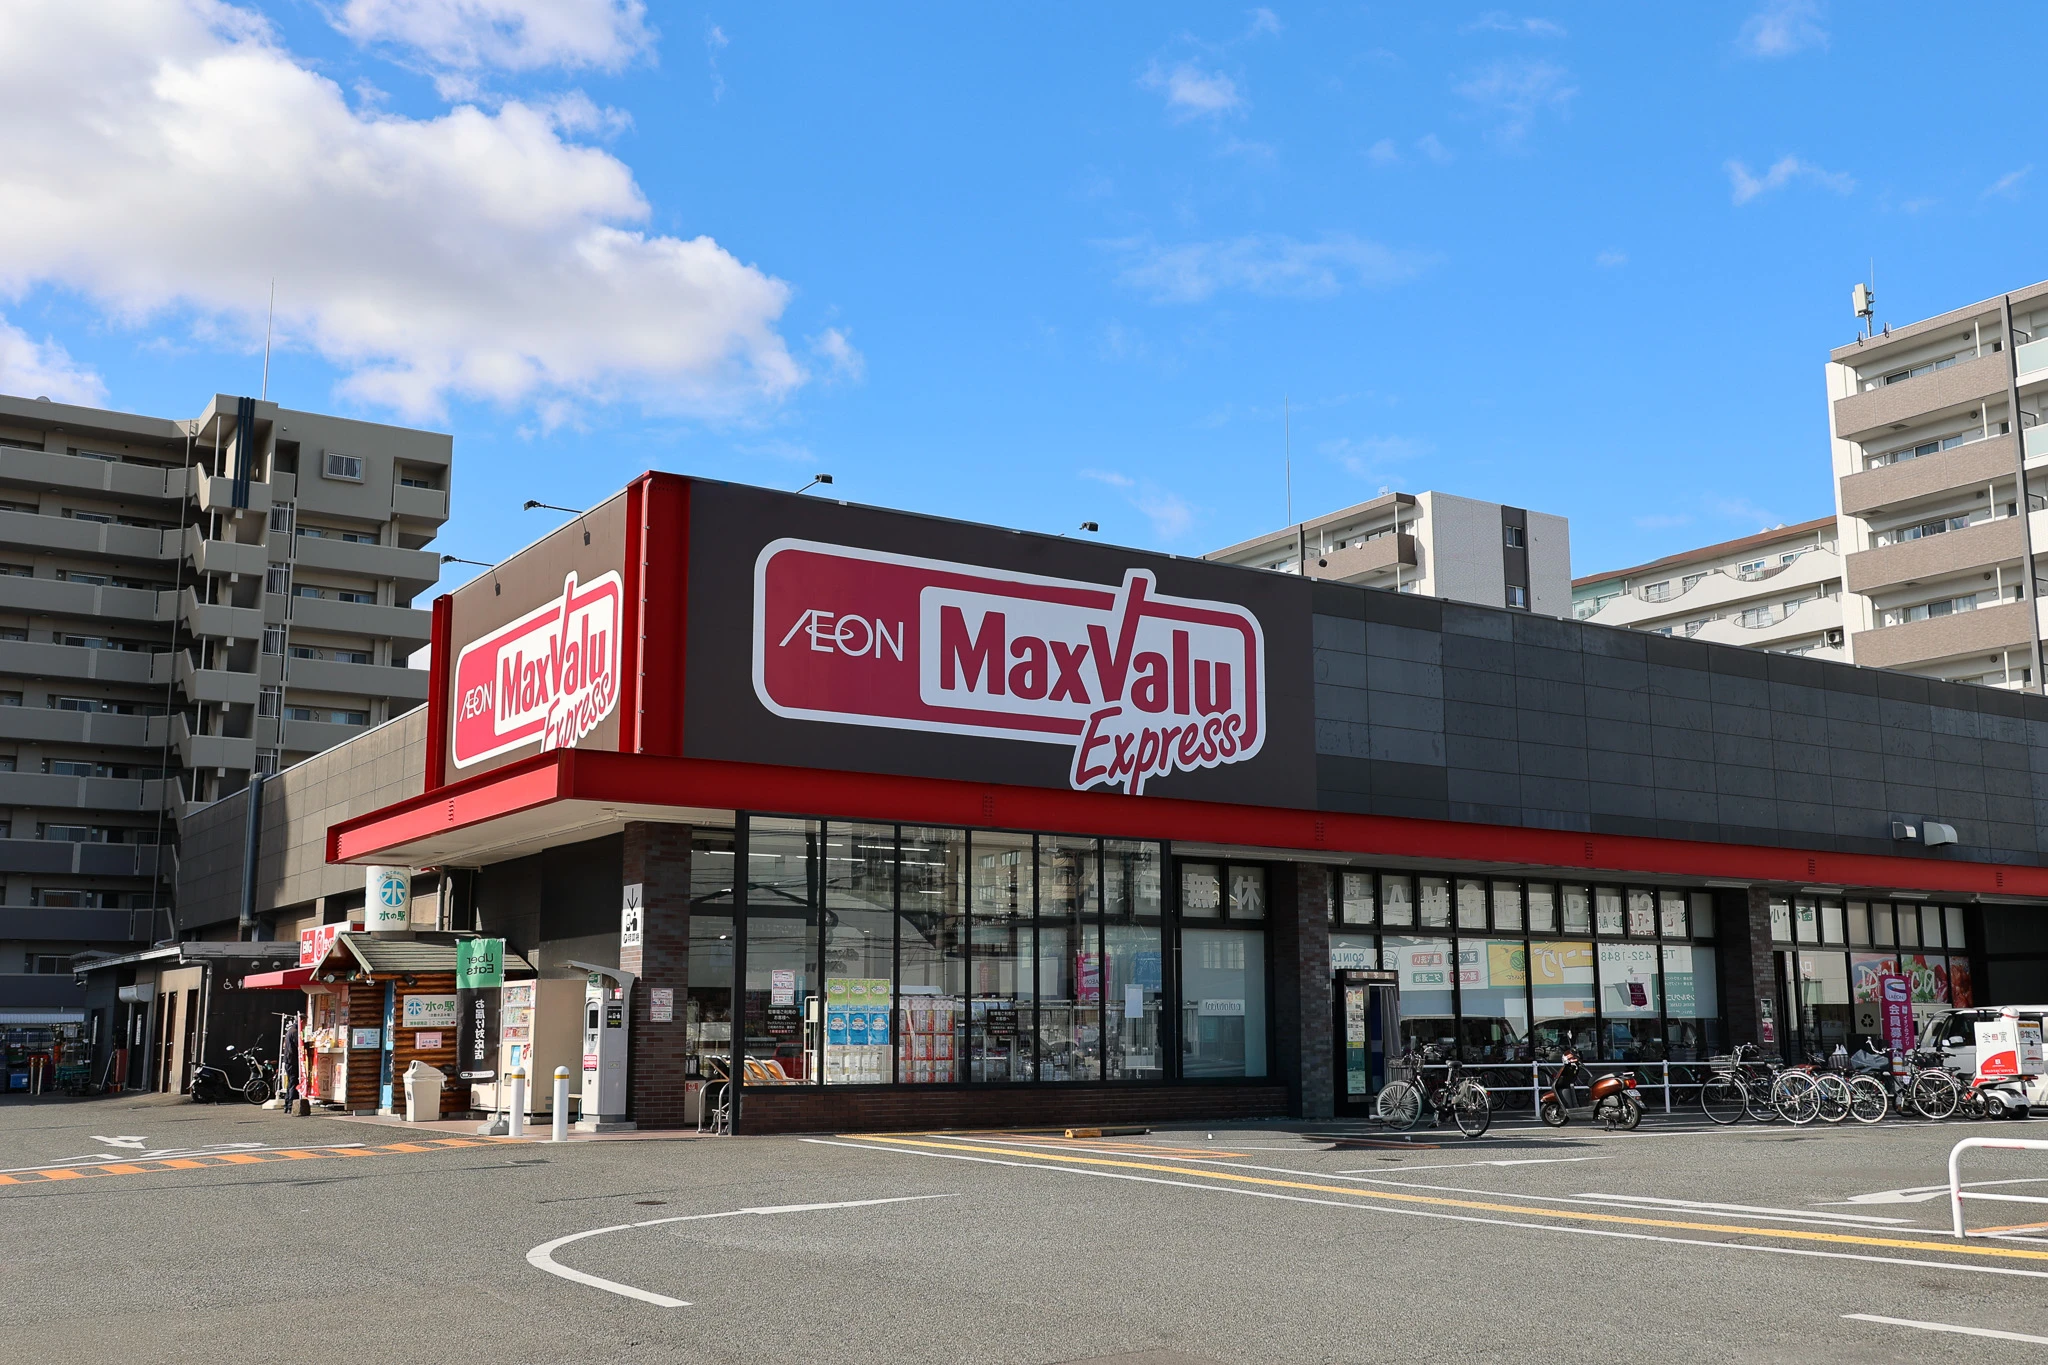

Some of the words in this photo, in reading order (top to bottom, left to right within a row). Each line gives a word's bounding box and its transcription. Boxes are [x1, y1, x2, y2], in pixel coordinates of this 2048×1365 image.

[501, 580, 606, 721] MaxValu
[779, 610, 904, 662] AEON
[940, 575, 1232, 716] MaxValu
[459, 680, 493, 723] AEON
[544, 672, 609, 752] Express
[1075, 705, 1243, 796] Express
[379, 911, 406, 921] 水の駅
[302, 940, 313, 954] BIG
[425, 1001, 455, 1012] 水の駅
